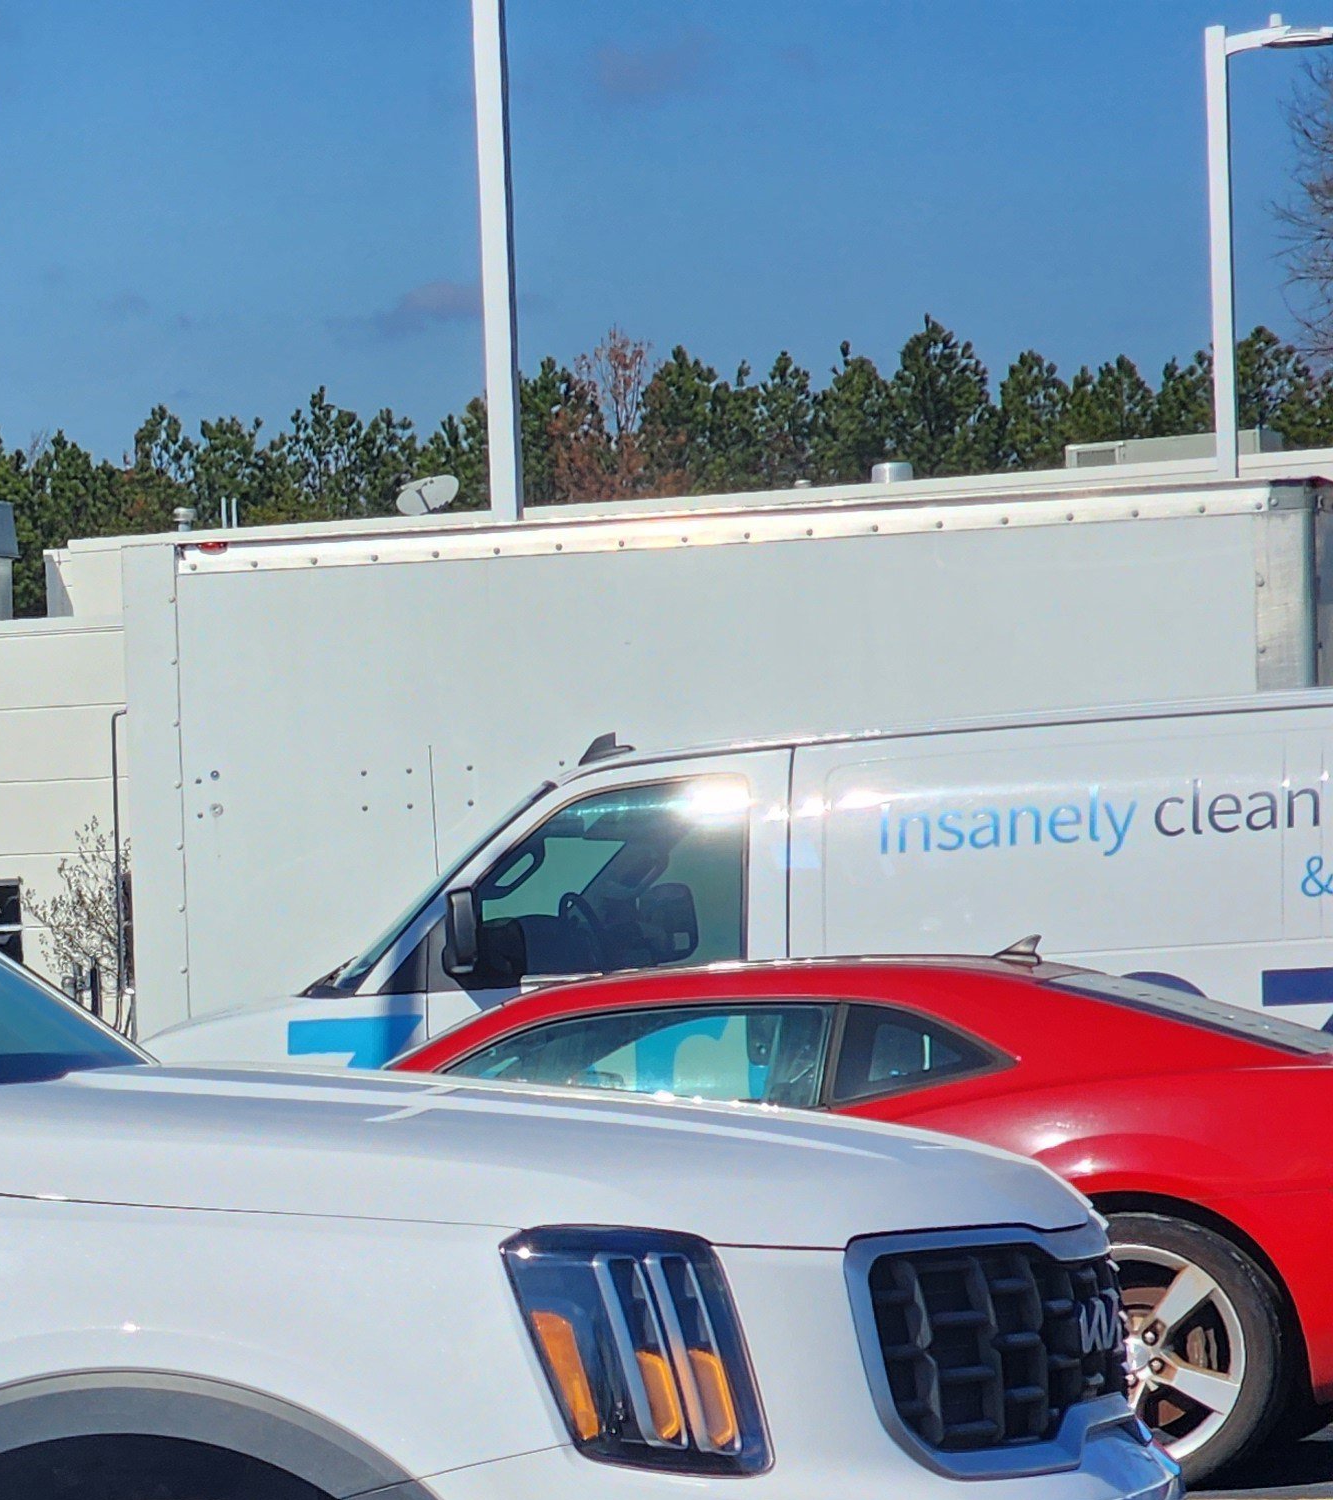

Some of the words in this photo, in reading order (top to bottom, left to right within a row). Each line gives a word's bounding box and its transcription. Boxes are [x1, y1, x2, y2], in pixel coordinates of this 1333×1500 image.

[879, 784, 1137, 857] Insanely
[1154, 778, 1321, 837] clean
[1300, 855, 1333, 897] &
